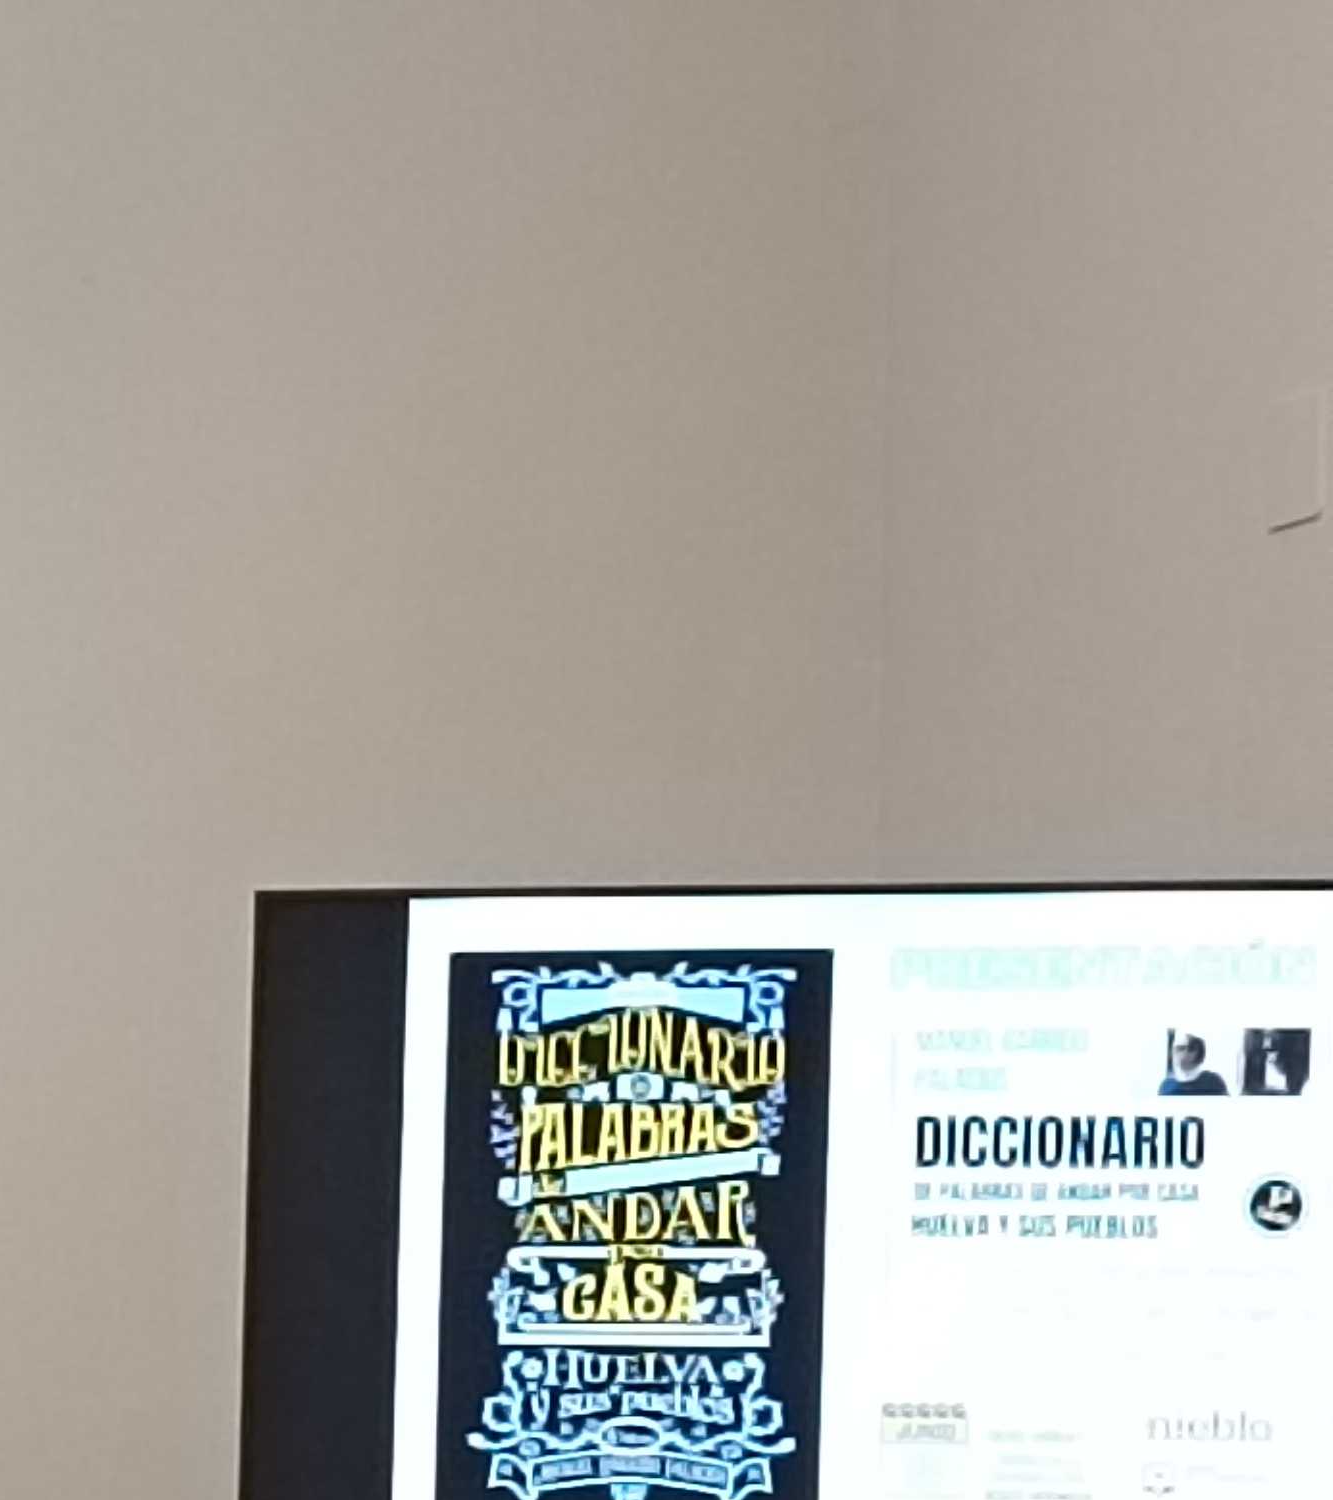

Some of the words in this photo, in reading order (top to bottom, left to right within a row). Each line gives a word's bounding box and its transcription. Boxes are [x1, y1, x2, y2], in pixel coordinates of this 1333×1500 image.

[519, 1100, 761, 1172] PALABRAS
[916, 1115, 1206, 1169] DICCIONARIO
[518, 1180, 757, 1248] ANDAR
[561, 1262, 702, 1323] CASA
[542, 1348, 719, 1389] HUELVA
